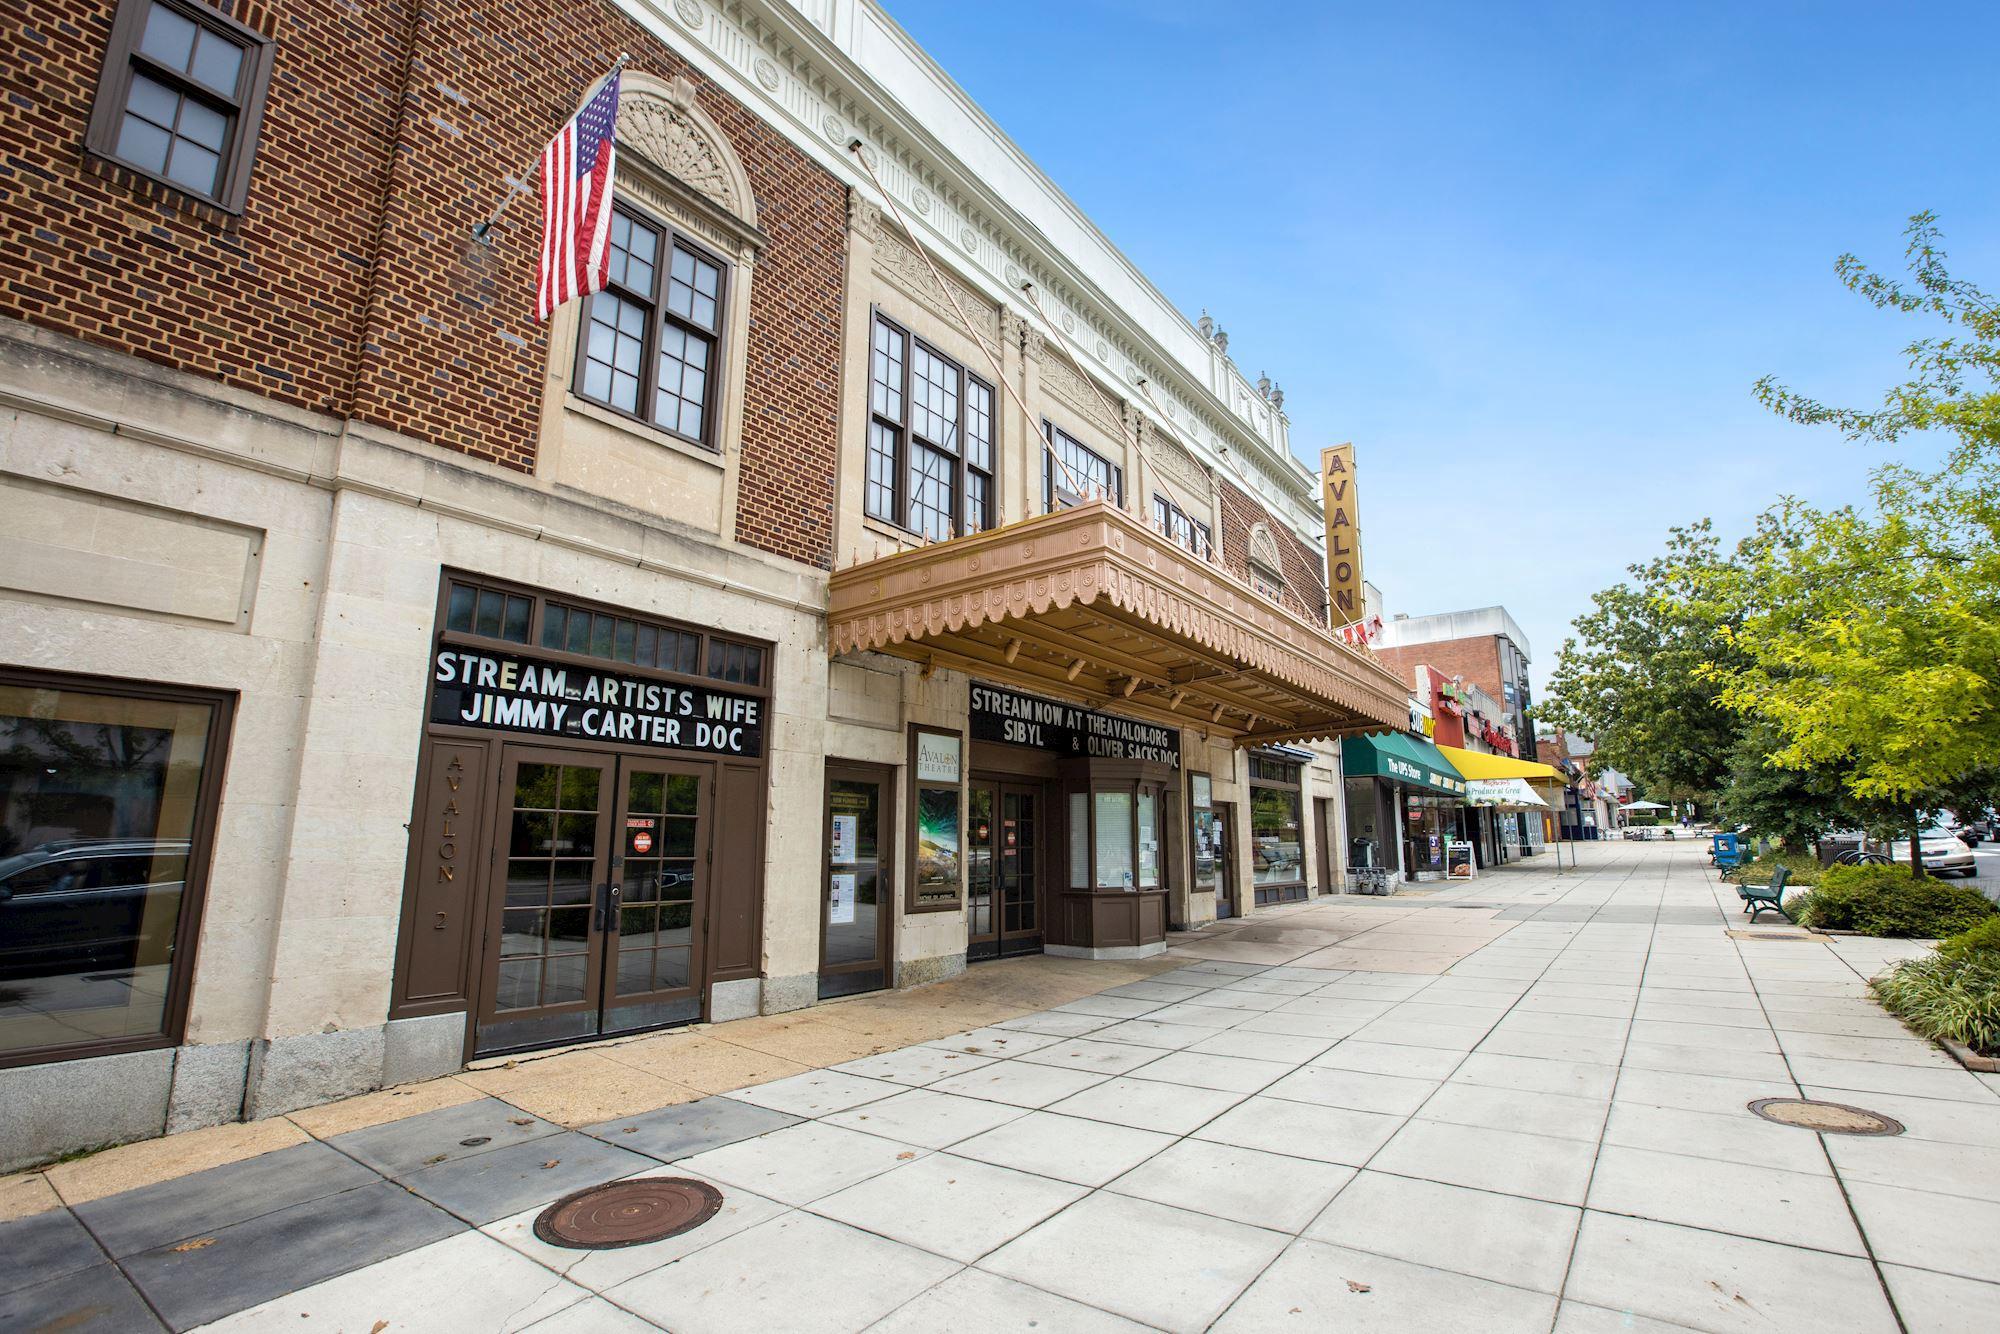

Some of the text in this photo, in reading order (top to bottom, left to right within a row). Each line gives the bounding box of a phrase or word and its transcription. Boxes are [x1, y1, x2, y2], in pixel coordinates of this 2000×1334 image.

[1328, 454, 1355, 611] AVALON
[436, 651, 757, 725] STREAM ARTISTS WIFE
[461, 693, 743, 752] JIMMY CARTER DOC
[972, 687, 1168, 747] STREAM NOW AT THEAVALON.ORG
[1409, 710, 1435, 738] SUBWAY
[1004, 719, 1043, 746] SIBYL
[1072, 736, 1079, 751] &
[1087, 735, 1179, 768] OLIVER SACKS DOC
[1388, 757, 1421, 780] The UPS Store
[1472, 786, 1497, 795] Produce
[439, 753, 463, 883] AVALON
[434, 911, 448, 930] 2
